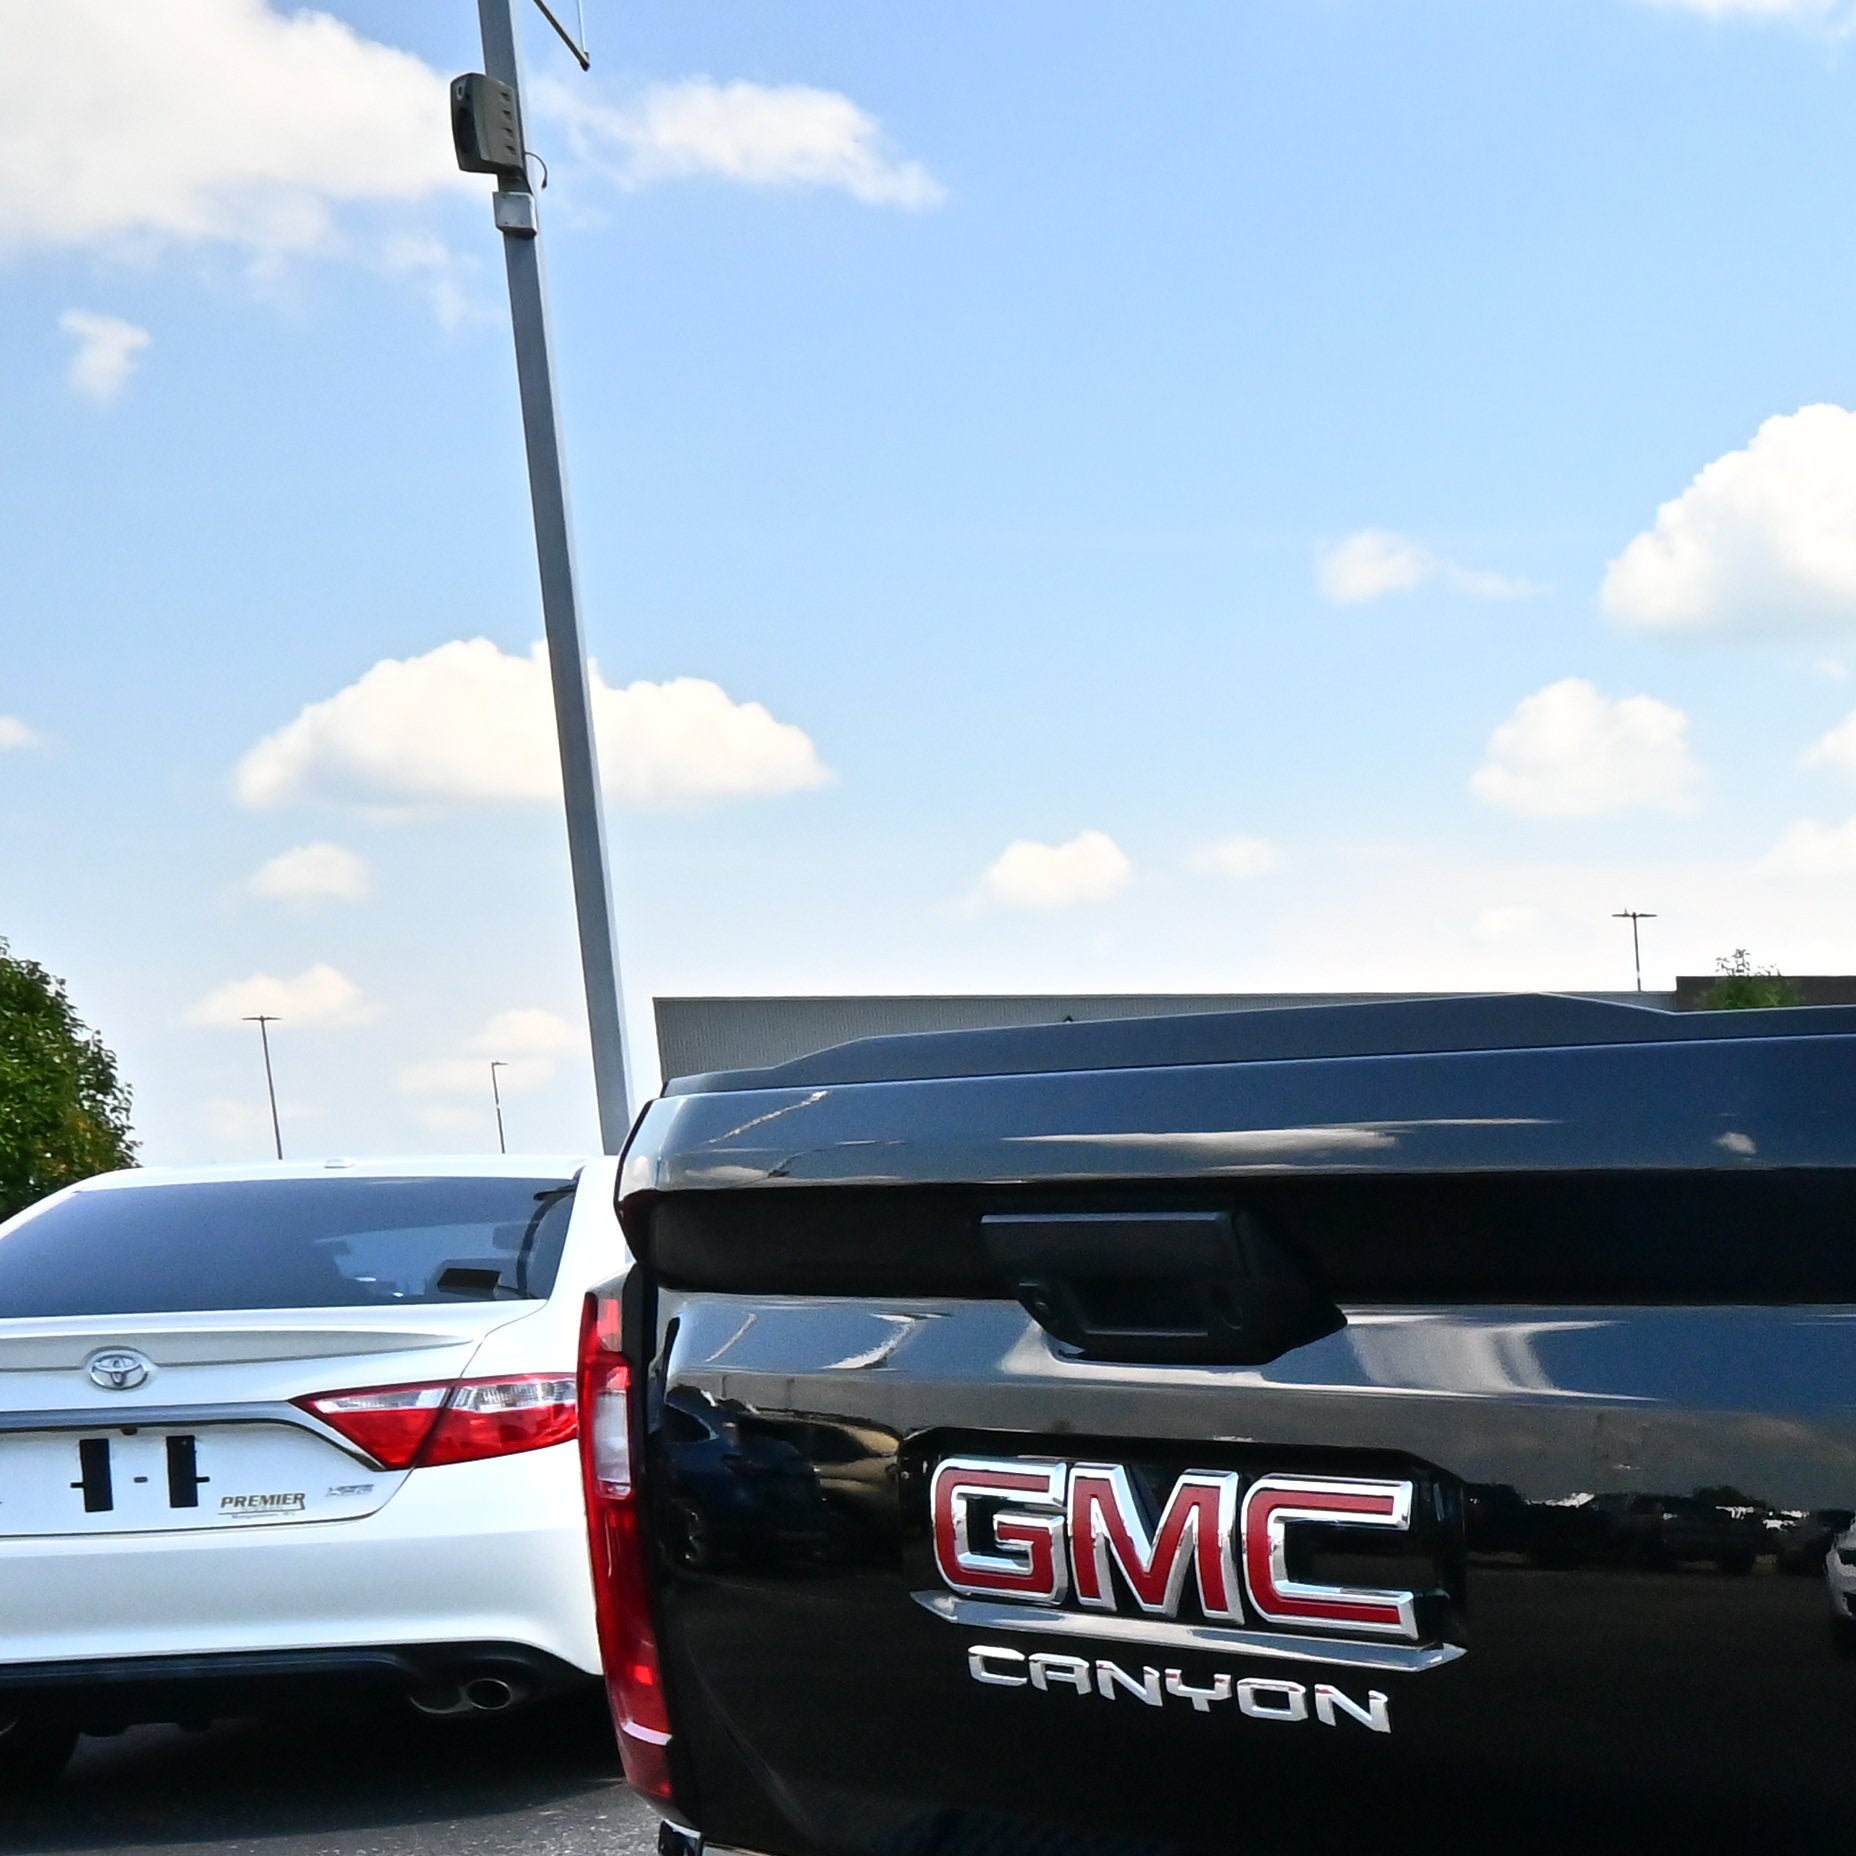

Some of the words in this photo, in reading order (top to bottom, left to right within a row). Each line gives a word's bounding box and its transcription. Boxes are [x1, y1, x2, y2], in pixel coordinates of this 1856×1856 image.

[219, 1492, 306, 1510] PREMIER
[930, 1455, 1420, 1641] GMC
[966, 1644, 1393, 1735] CANYON
